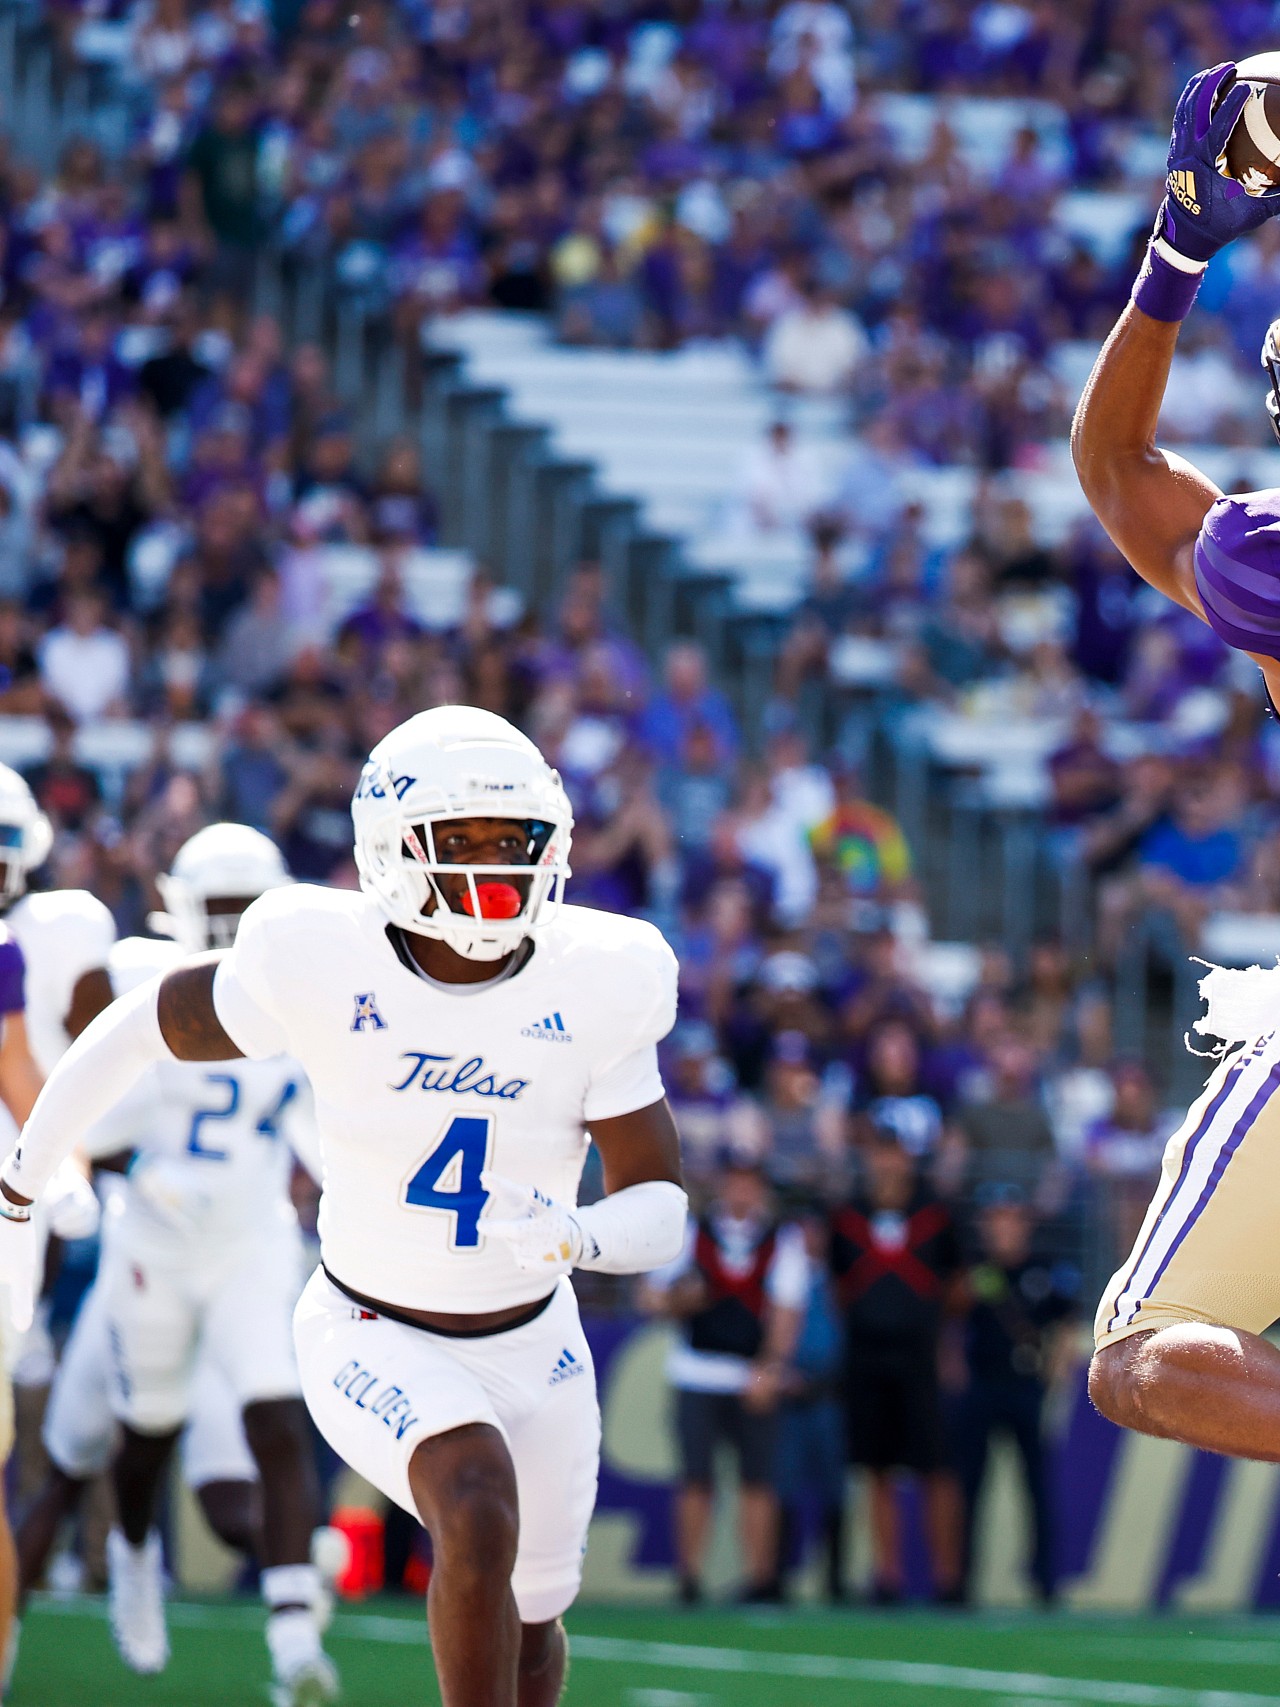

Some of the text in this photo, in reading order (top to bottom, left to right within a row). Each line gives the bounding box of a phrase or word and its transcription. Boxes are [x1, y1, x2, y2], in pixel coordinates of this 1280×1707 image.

[1166, 170, 1202, 216] adidas
[520, 1025, 574, 1044] adidas
[387, 1050, 532, 1100] Tulsa
[401, 1110, 495, 1254] 4
[333, 1360, 418, 1440] GOLDEN
